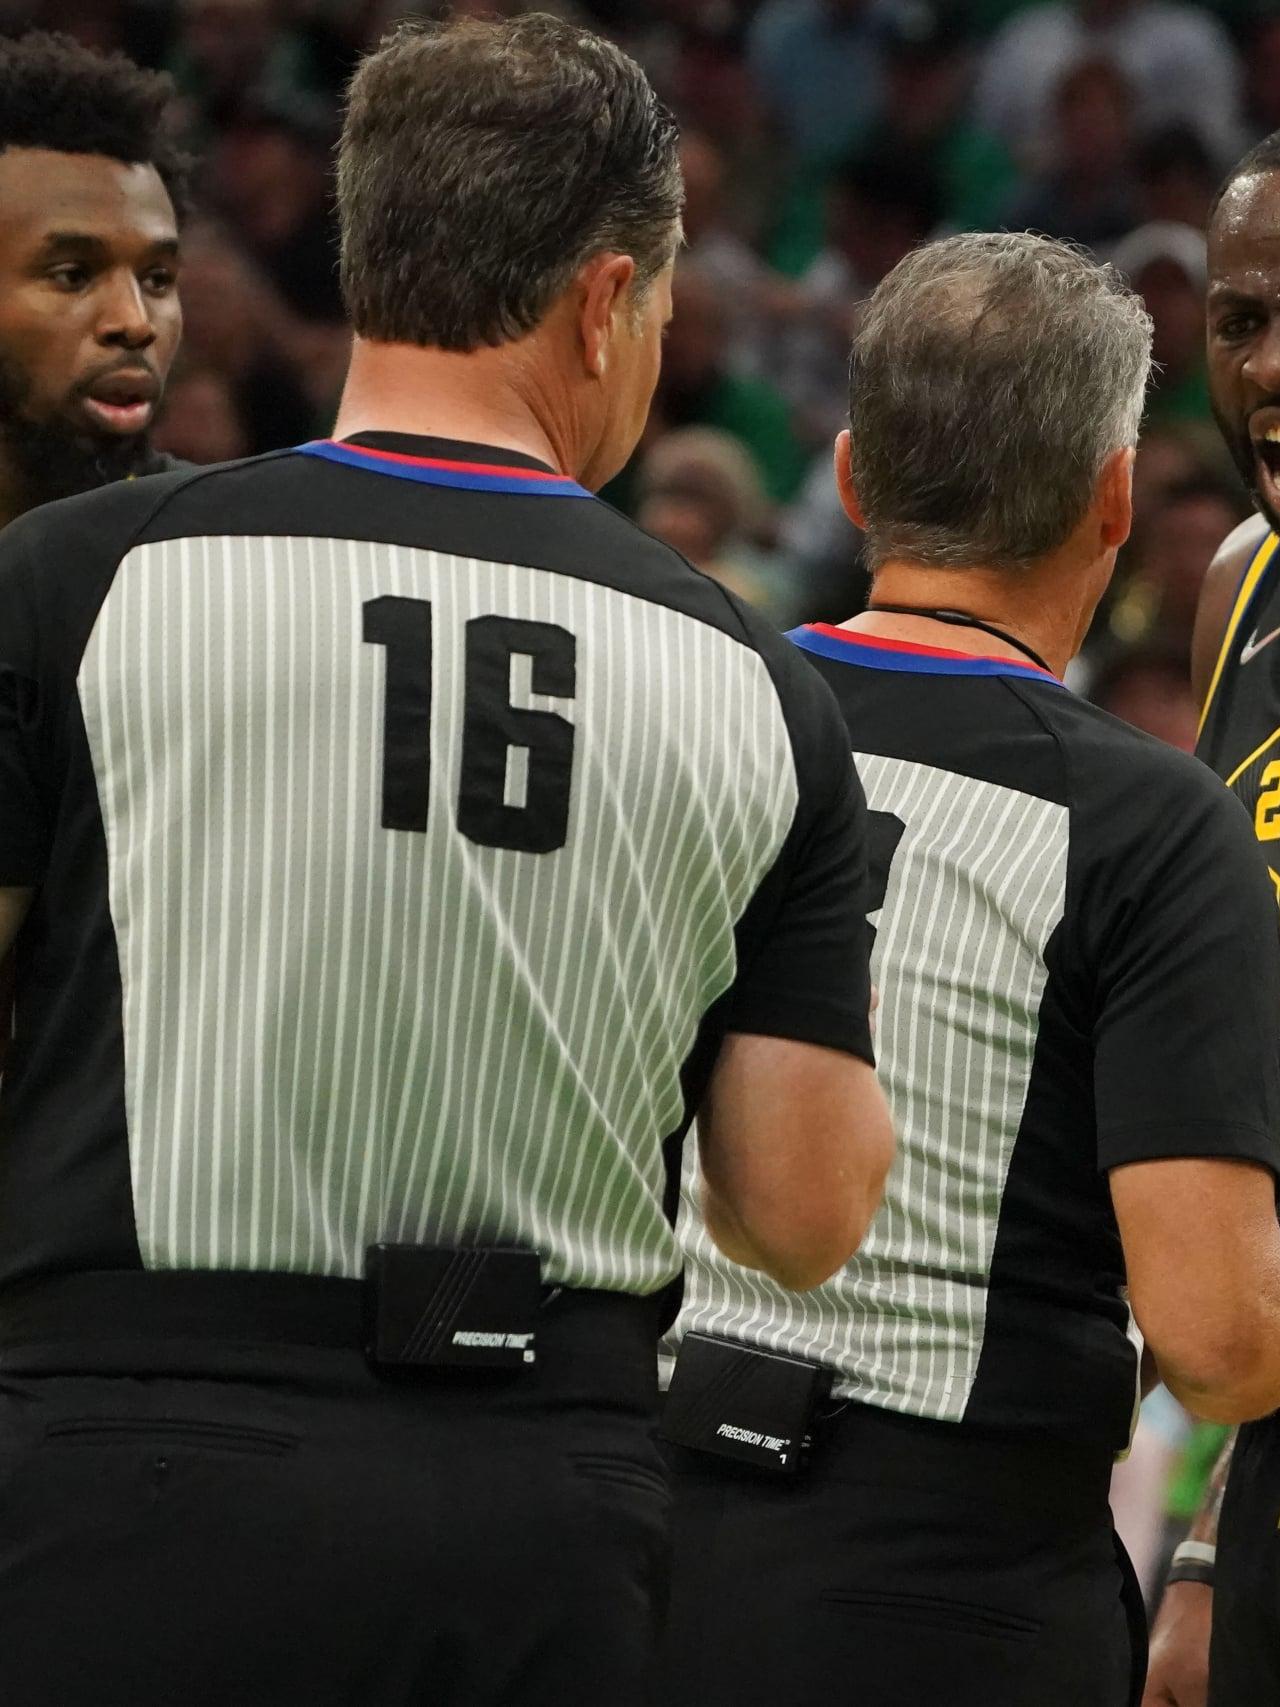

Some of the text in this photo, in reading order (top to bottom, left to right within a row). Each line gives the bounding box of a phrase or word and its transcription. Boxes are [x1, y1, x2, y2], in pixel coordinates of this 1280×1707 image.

[361, 594, 577, 855] 16
[452, 1331, 506, 1347] PRECISION
[717, 1423, 764, 1446] PRECISION
[762, 1435, 786, 1451] TIME
[779, 1453, 787, 1464] 1
